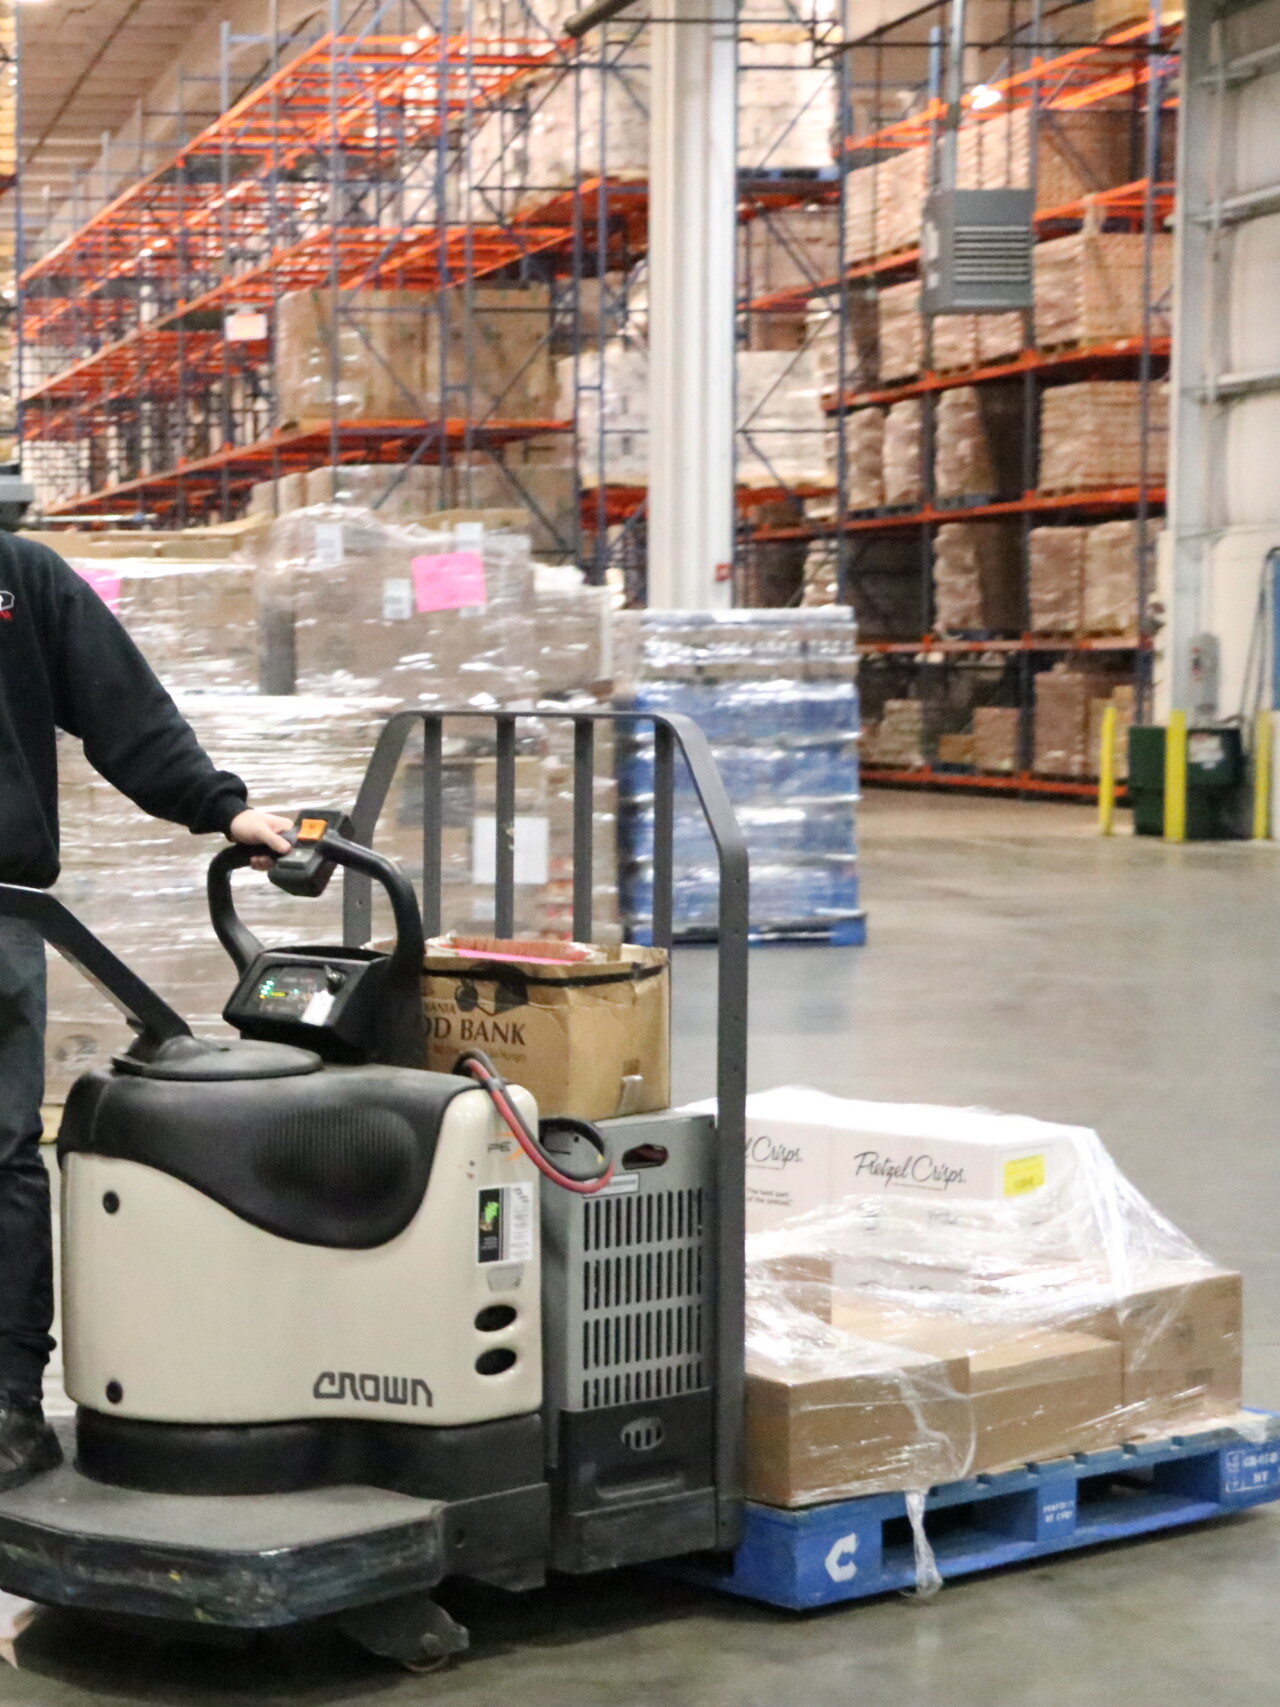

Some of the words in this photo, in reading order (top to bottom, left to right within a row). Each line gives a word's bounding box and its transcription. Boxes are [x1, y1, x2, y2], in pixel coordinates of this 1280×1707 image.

[424, 1017, 452, 1040] OD
[460, 1018, 526, 1046] BANK
[854, 1151, 912, 1188] Pretzel
